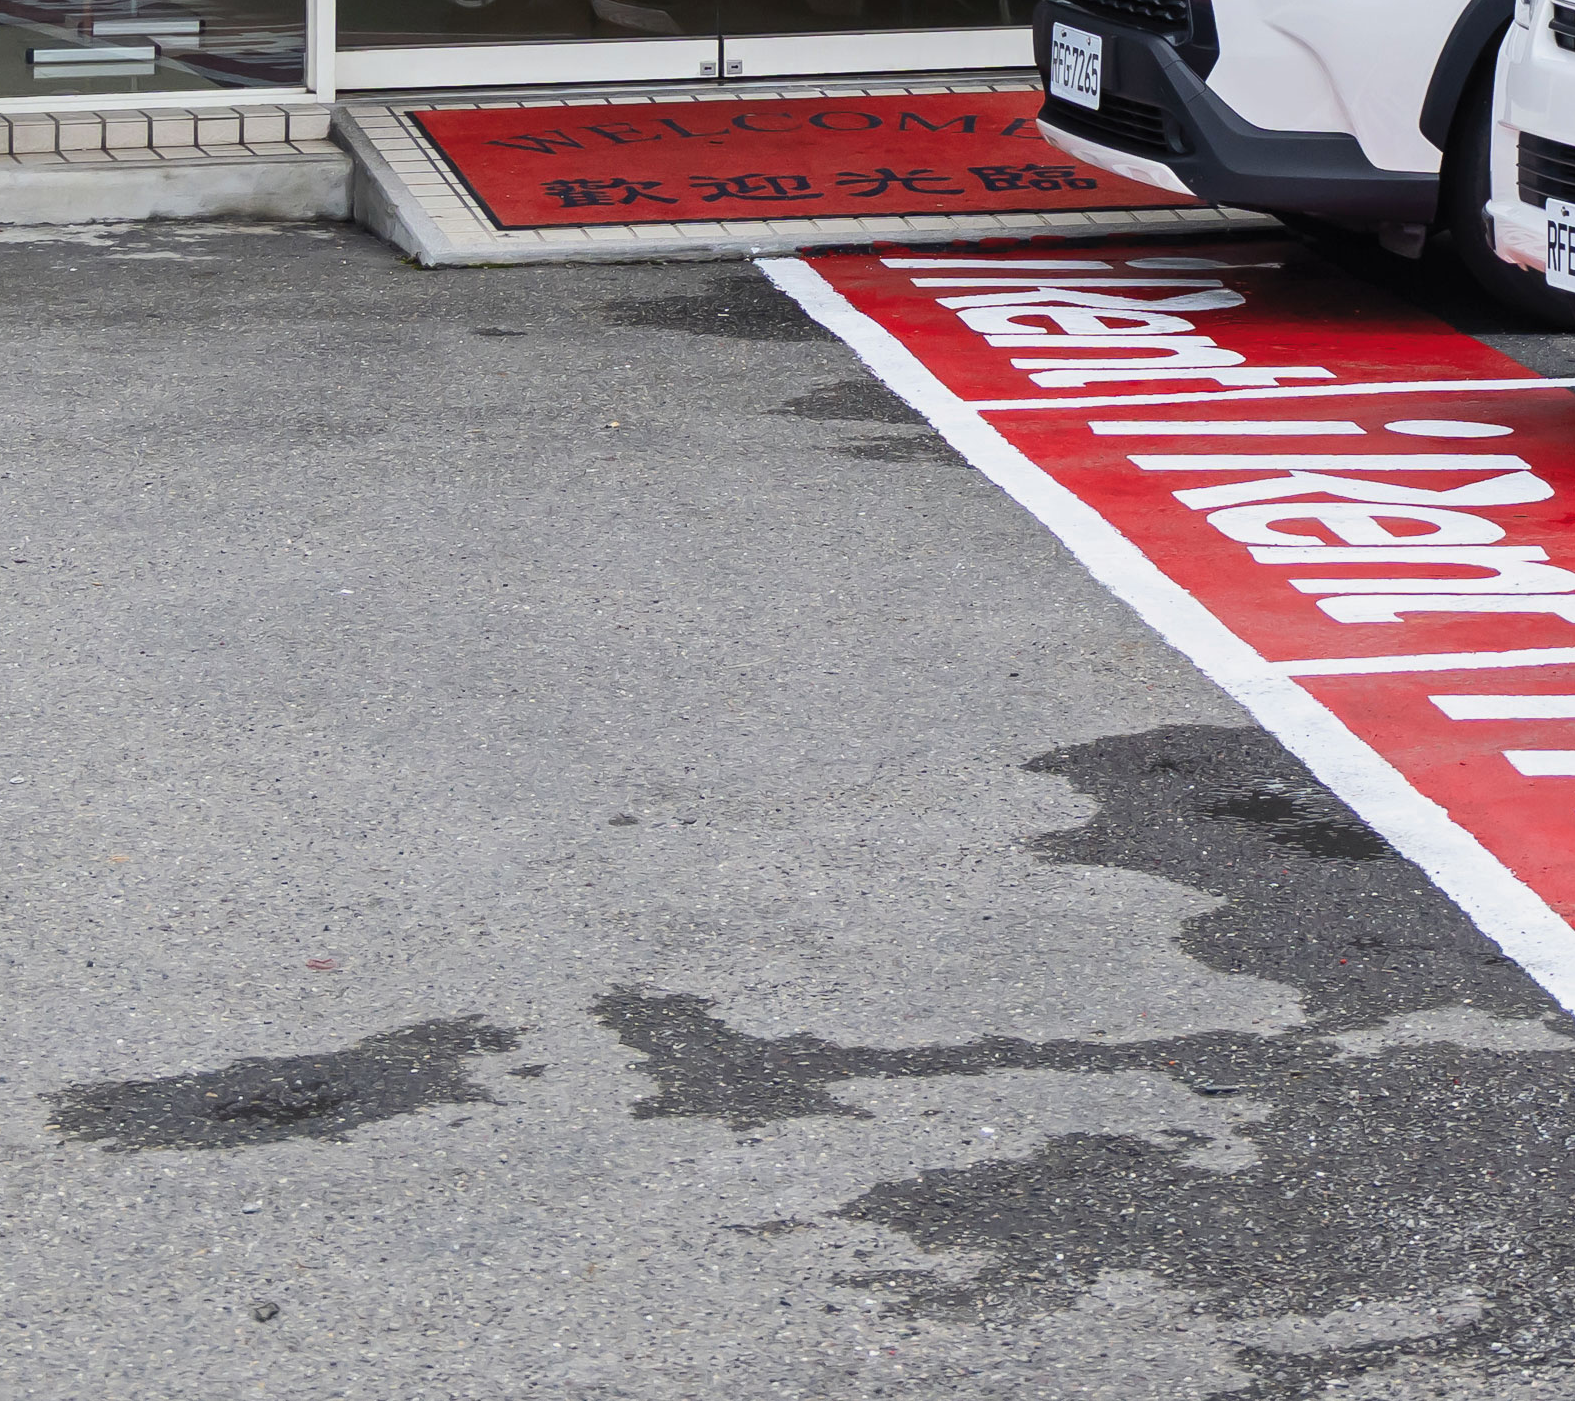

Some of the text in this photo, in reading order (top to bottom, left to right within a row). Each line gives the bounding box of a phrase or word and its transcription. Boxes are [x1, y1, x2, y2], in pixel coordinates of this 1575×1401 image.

[1052, 40, 1099, 96] RFG-7265
[540, 163, 1098, 210] 歡迎光臨
